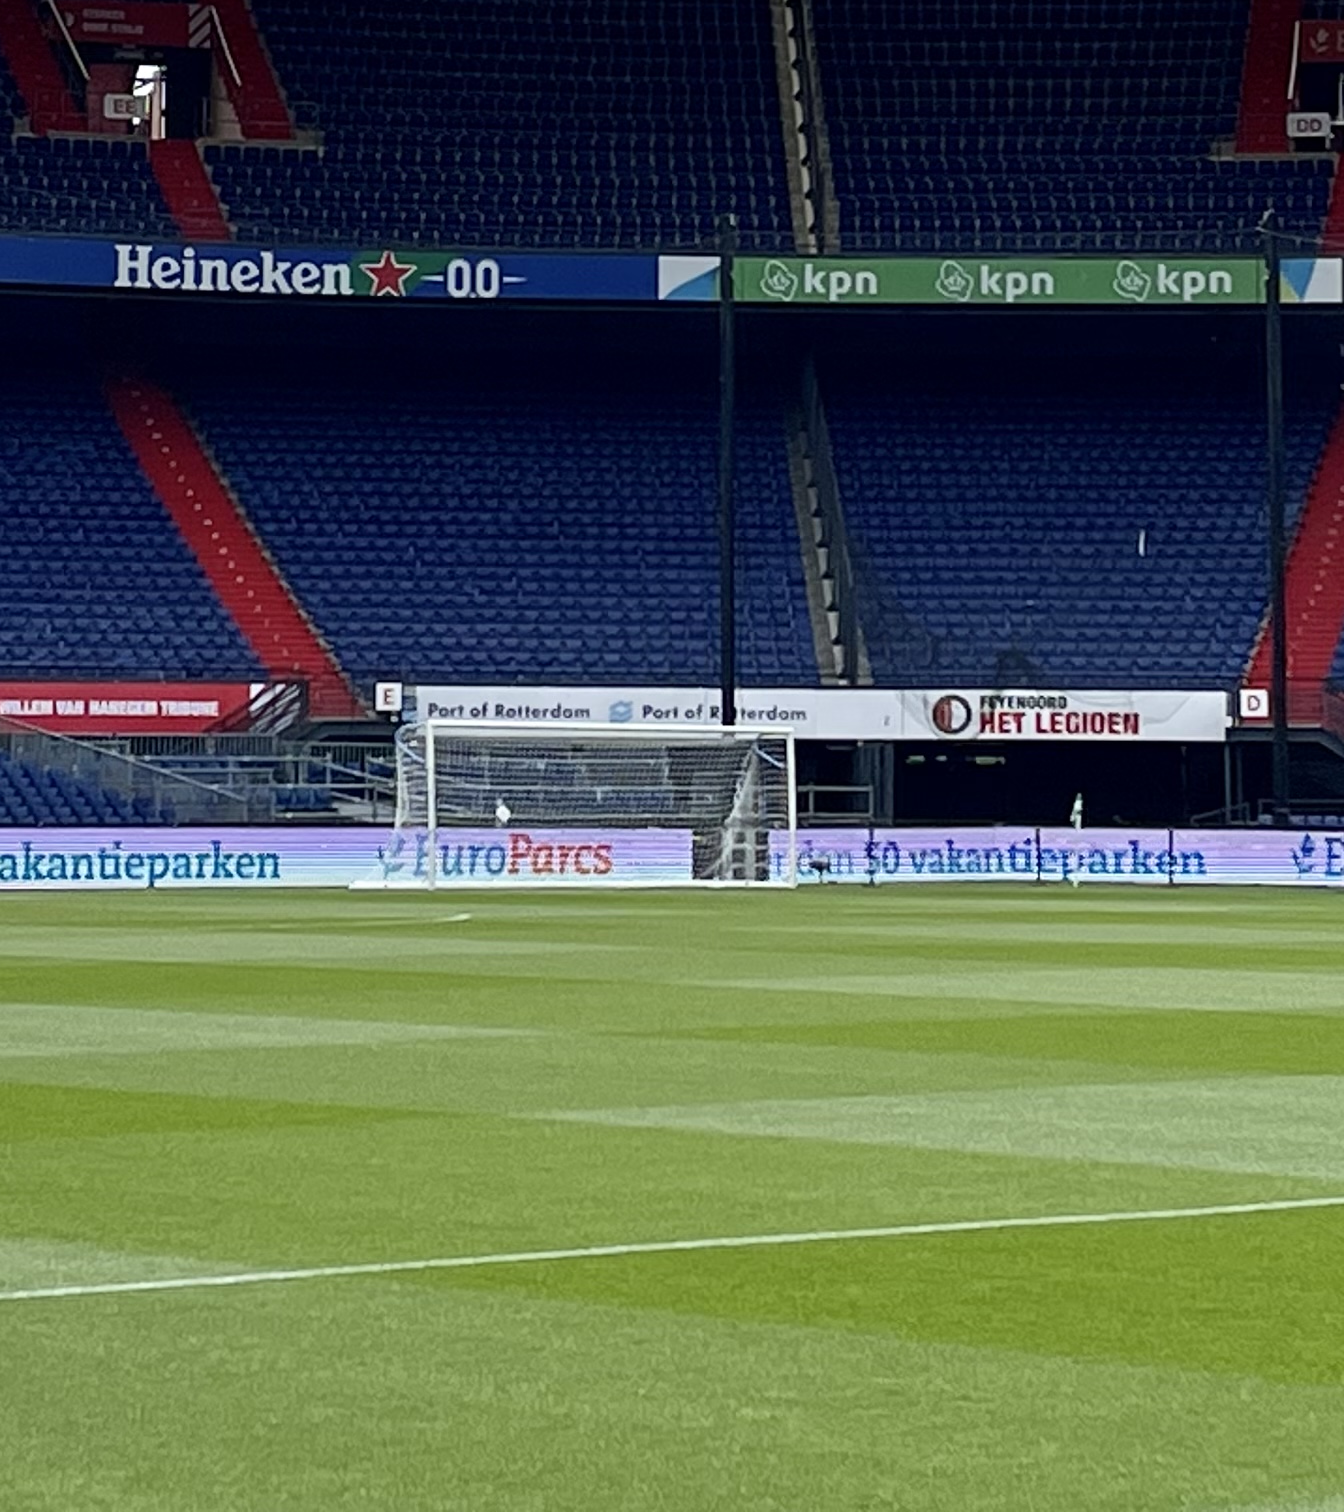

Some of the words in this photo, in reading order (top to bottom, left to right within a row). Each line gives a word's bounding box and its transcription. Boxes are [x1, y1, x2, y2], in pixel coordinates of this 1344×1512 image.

[112, 99, 136, 115] EE
[113, 243, 354, 296] Heineken
[803, 262, 878, 302] kpn
[979, 263, 1054, 302] kpn
[1157, 262, 1233, 302] kpn
[383, 688, 395, 705] E
[979, 695, 1068, 710] FEYENOORD
[1247, 695, 1260, 712] D
[427, 702, 464, 718] Port
[469, 701, 488, 718] of
[494, 702, 591, 719] Rotterdam
[642, 704, 678, 719] Port
[684, 703, 703, 720] of
[709, 705, 807, 721] Rterdam
[979, 711, 1026, 734] HET
[1035, 711, 1140, 735] LEGIOEN
[909, 838, 1208, 882] vakantieparken
